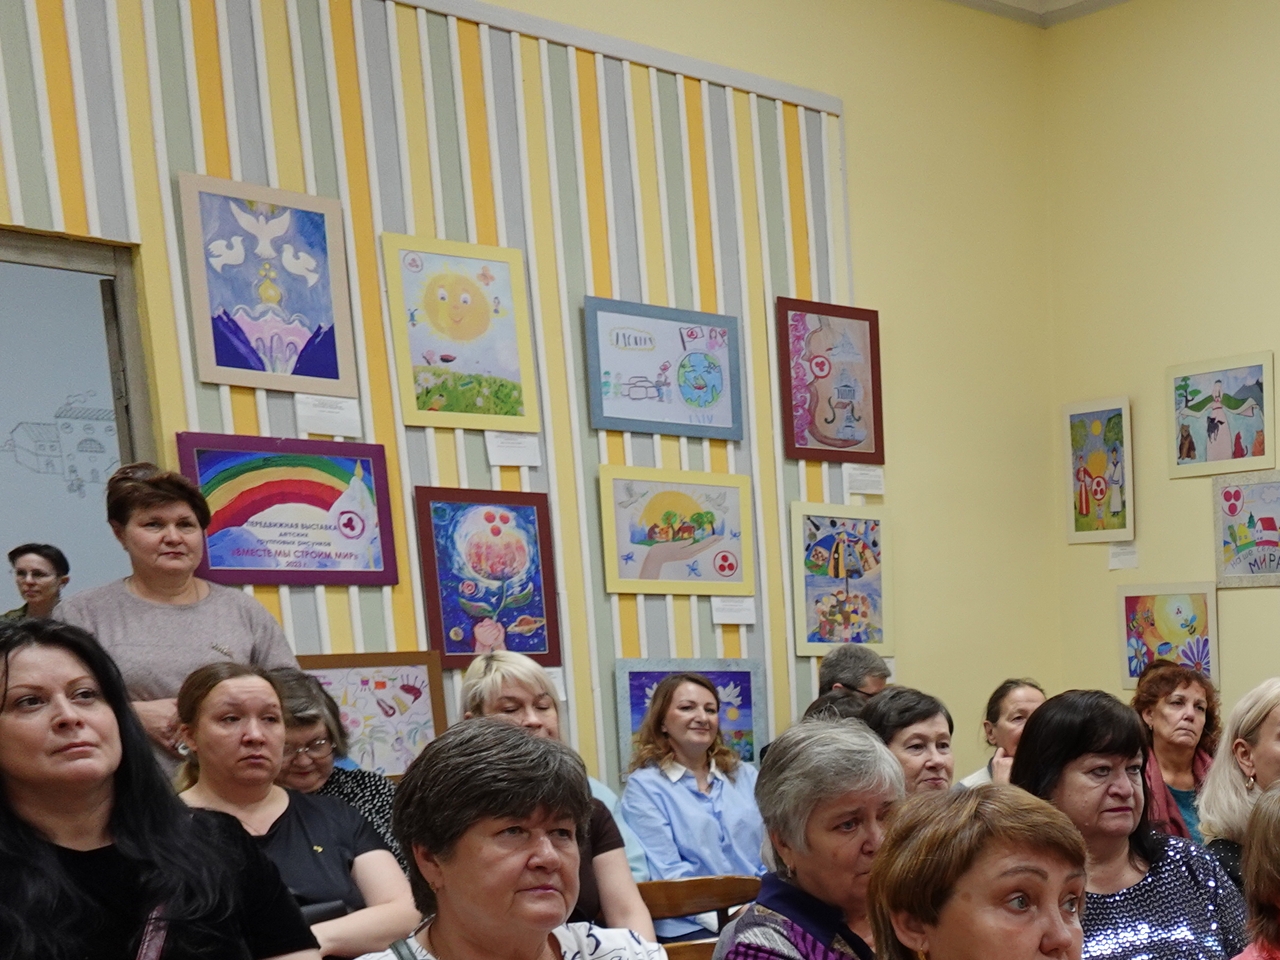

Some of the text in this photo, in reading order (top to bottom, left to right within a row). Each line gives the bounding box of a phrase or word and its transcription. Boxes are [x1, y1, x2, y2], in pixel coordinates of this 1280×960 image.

[301, 522, 338, 531] ВЫСТАВКА
[274, 549, 291, 558] МЫ
[293, 550, 333, 560] СТРОИМ
